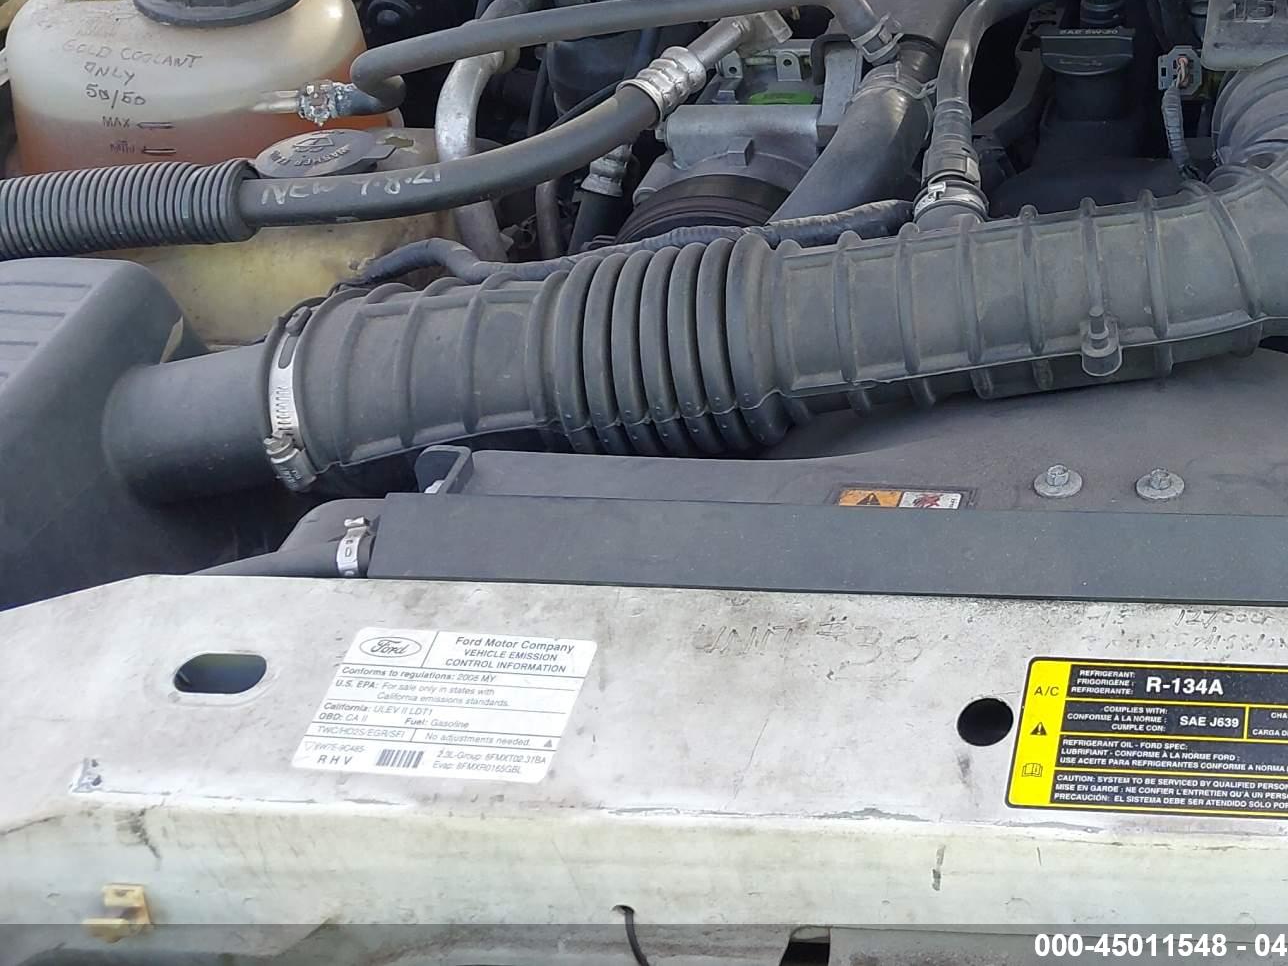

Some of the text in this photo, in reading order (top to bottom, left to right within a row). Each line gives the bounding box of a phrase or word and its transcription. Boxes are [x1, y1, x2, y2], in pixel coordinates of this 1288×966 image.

[84, 62, 135, 86] ONLY
[86, 84, 146, 109] 50/50
[102, 116, 130, 128] MAX
[261, 181, 337, 205] NEW
[371, 639, 407, 655] Ford
[456, 637, 575, 654] Ford Motor Company
[464, 649, 557, 661] VEHICLE EMISSION
[445, 658, 566, 673] CONTROL INFORMATION
[342, 667, 497, 683] Conforms to regulations: MY
[1079, 669, 1135, 678] REFRIGERANT:
[335, 680, 379, 689] U.S. EPA:
[1146, 677, 1224, 695] R-134A
[1034, 686, 1060, 696] A/C
[1071, 686, 1134, 695] REFRIGERANTE:
[377, 691, 419, 702] California
[324, 702, 372, 712] California:
[1104, 706, 1168, 715] COMPLIES WITH:
[319, 713, 343, 721] OBD:
[1180, 716, 1239, 728] SAE J639
[404, 717, 470, 729] Fuel: Gasoline
[1111, 723, 1165, 732] CUMPLE CON:
[1252, 728, 1280, 737] CARGA
[425, 733, 438, 741] No
[441, 733, 494, 744] adjustments
[1062, 739, 1118, 748] REFRIGERANT
[1057, 774, 1095, 783] CAUTION:
[1097, 776, 1130, 784] SYSTEM
[1145, 777, 1155, 785] BE
[1158, 778, 1198, 786] SERVICED
[1213, 780, 1255, 789] QUALIFIED
[1055, 784, 1075, 792] MISE
[1077, 784, 1090, 792] EN
[1092, 785, 1118, 793] GARDE
[1138, 787, 1174, 795] CONFIER
[1126, 796, 1161, 804] SISTEMA
[1205, 799, 1246, 807] ATENDIDO
